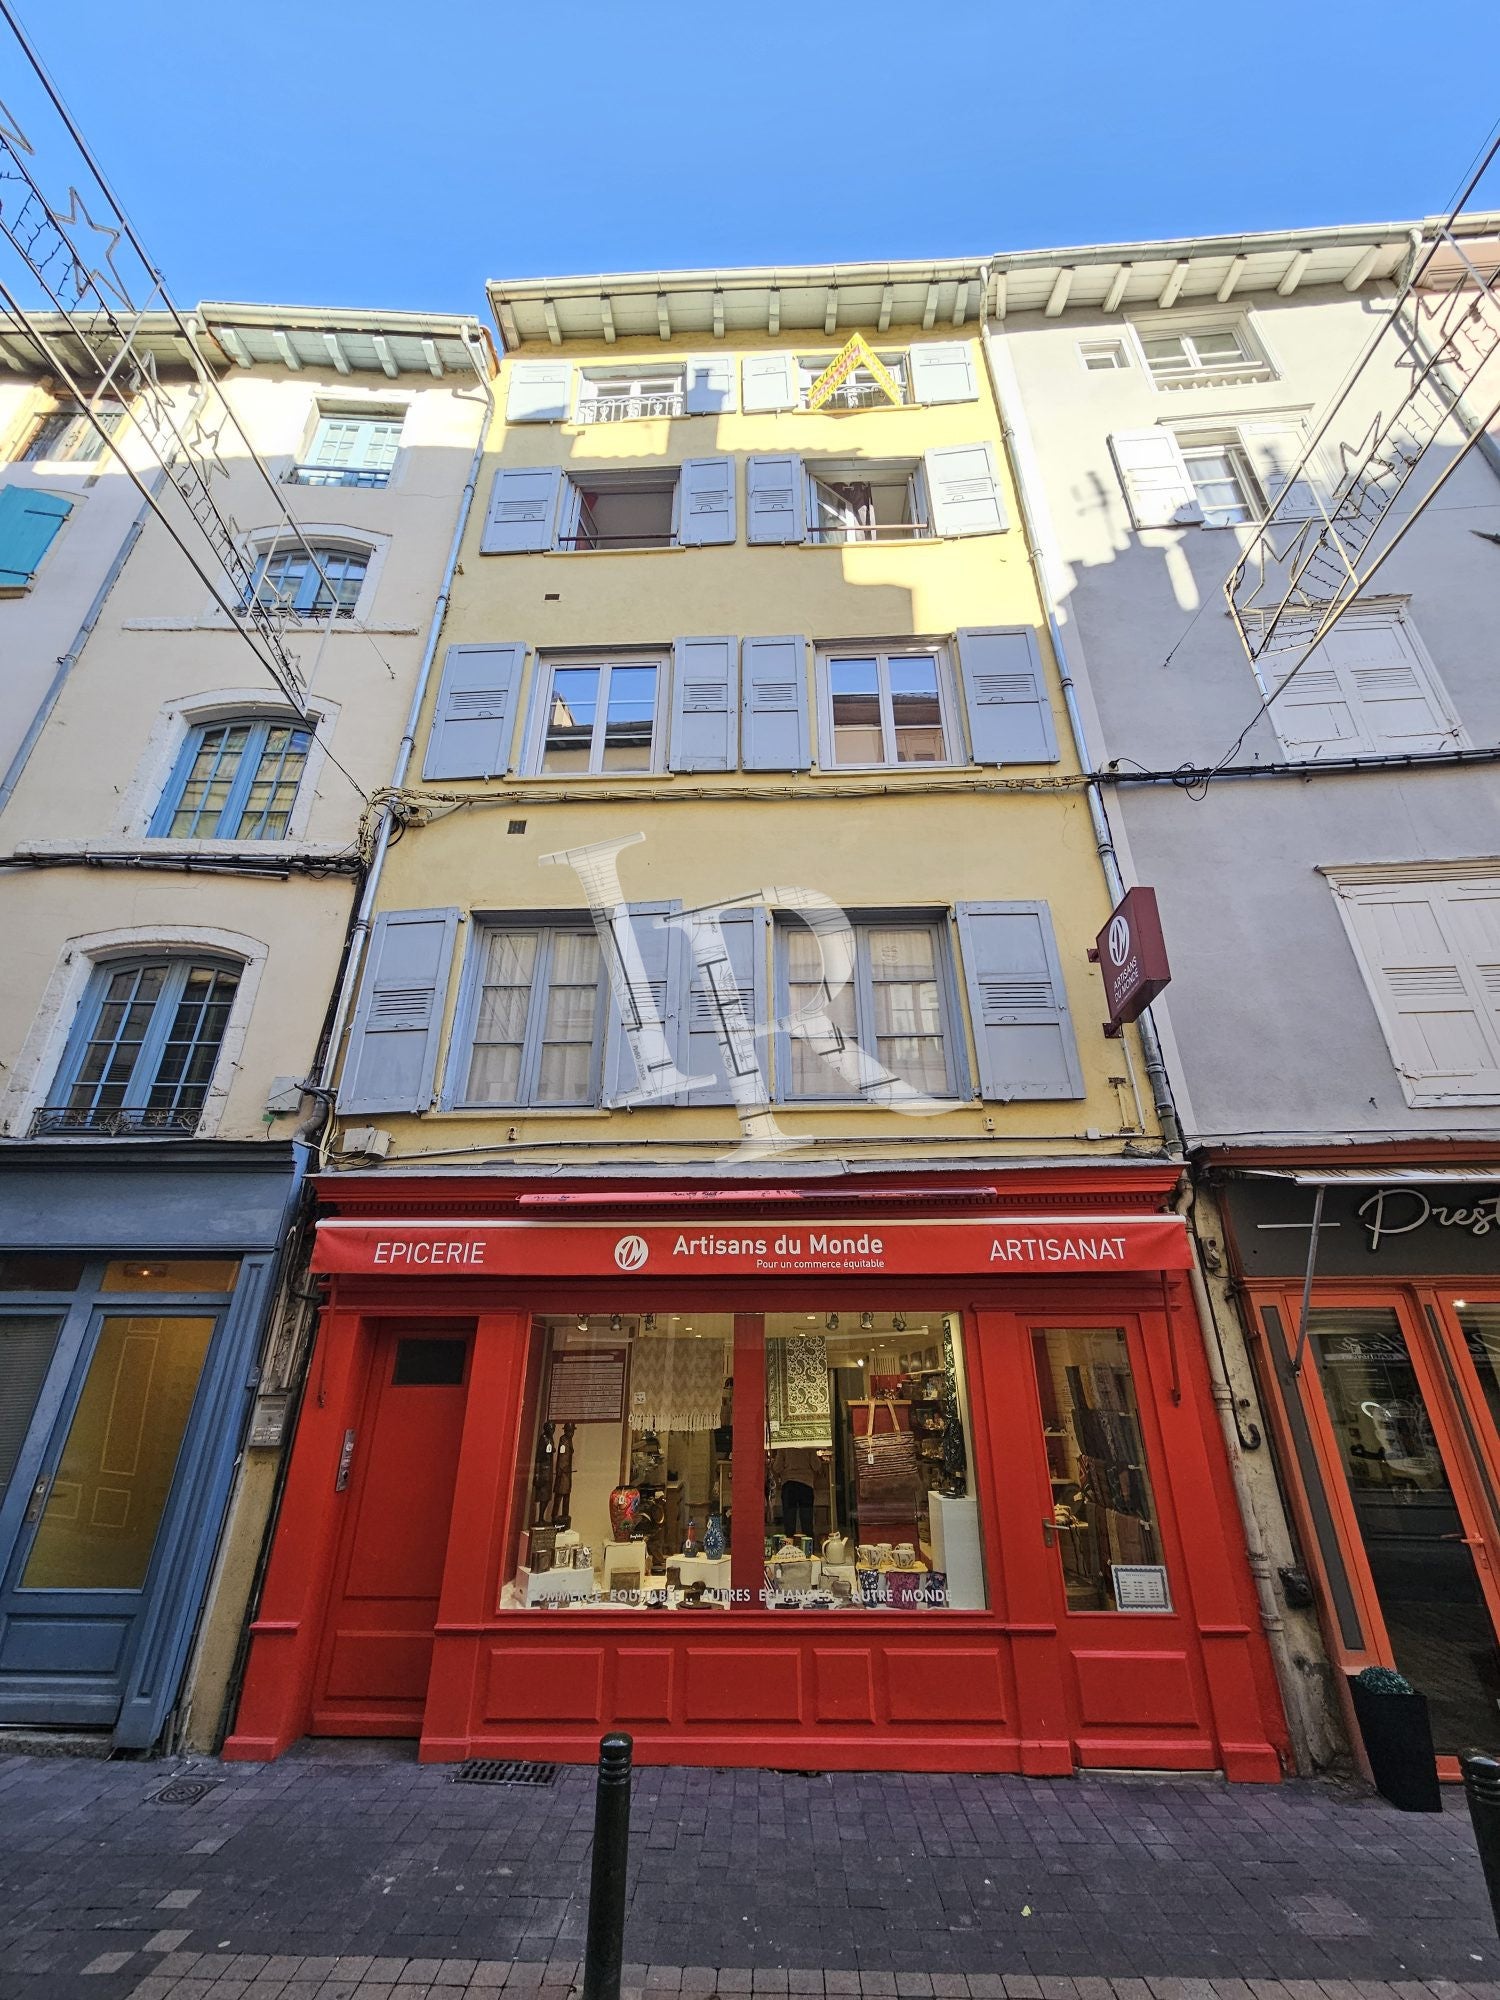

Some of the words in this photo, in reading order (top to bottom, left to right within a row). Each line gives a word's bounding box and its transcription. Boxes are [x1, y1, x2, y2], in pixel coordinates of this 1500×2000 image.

[1113, 955, 1137, 989] ARTISANS
[1121, 967, 1138, 994] MONDE
[373, 1242, 487, 1264] EPICERIE
[672, 1234, 768, 1256] Artisans
[774, 1234, 801, 1255] du
[809, 1233, 884, 1255] Monde
[990, 1238, 1126, 1262] ARTISANAT
[756, 1259, 778, 1269] Pour
[780, 1261, 793, 1269] un
[794, 1260, 841, 1269] commerce
[843, 1257, 885, 1270] équitable
[702, 1588, 751, 1602] AUTRES
[852, 1588, 894, 1602] AUTRE
[901, 1588, 953, 1602] MONDE
